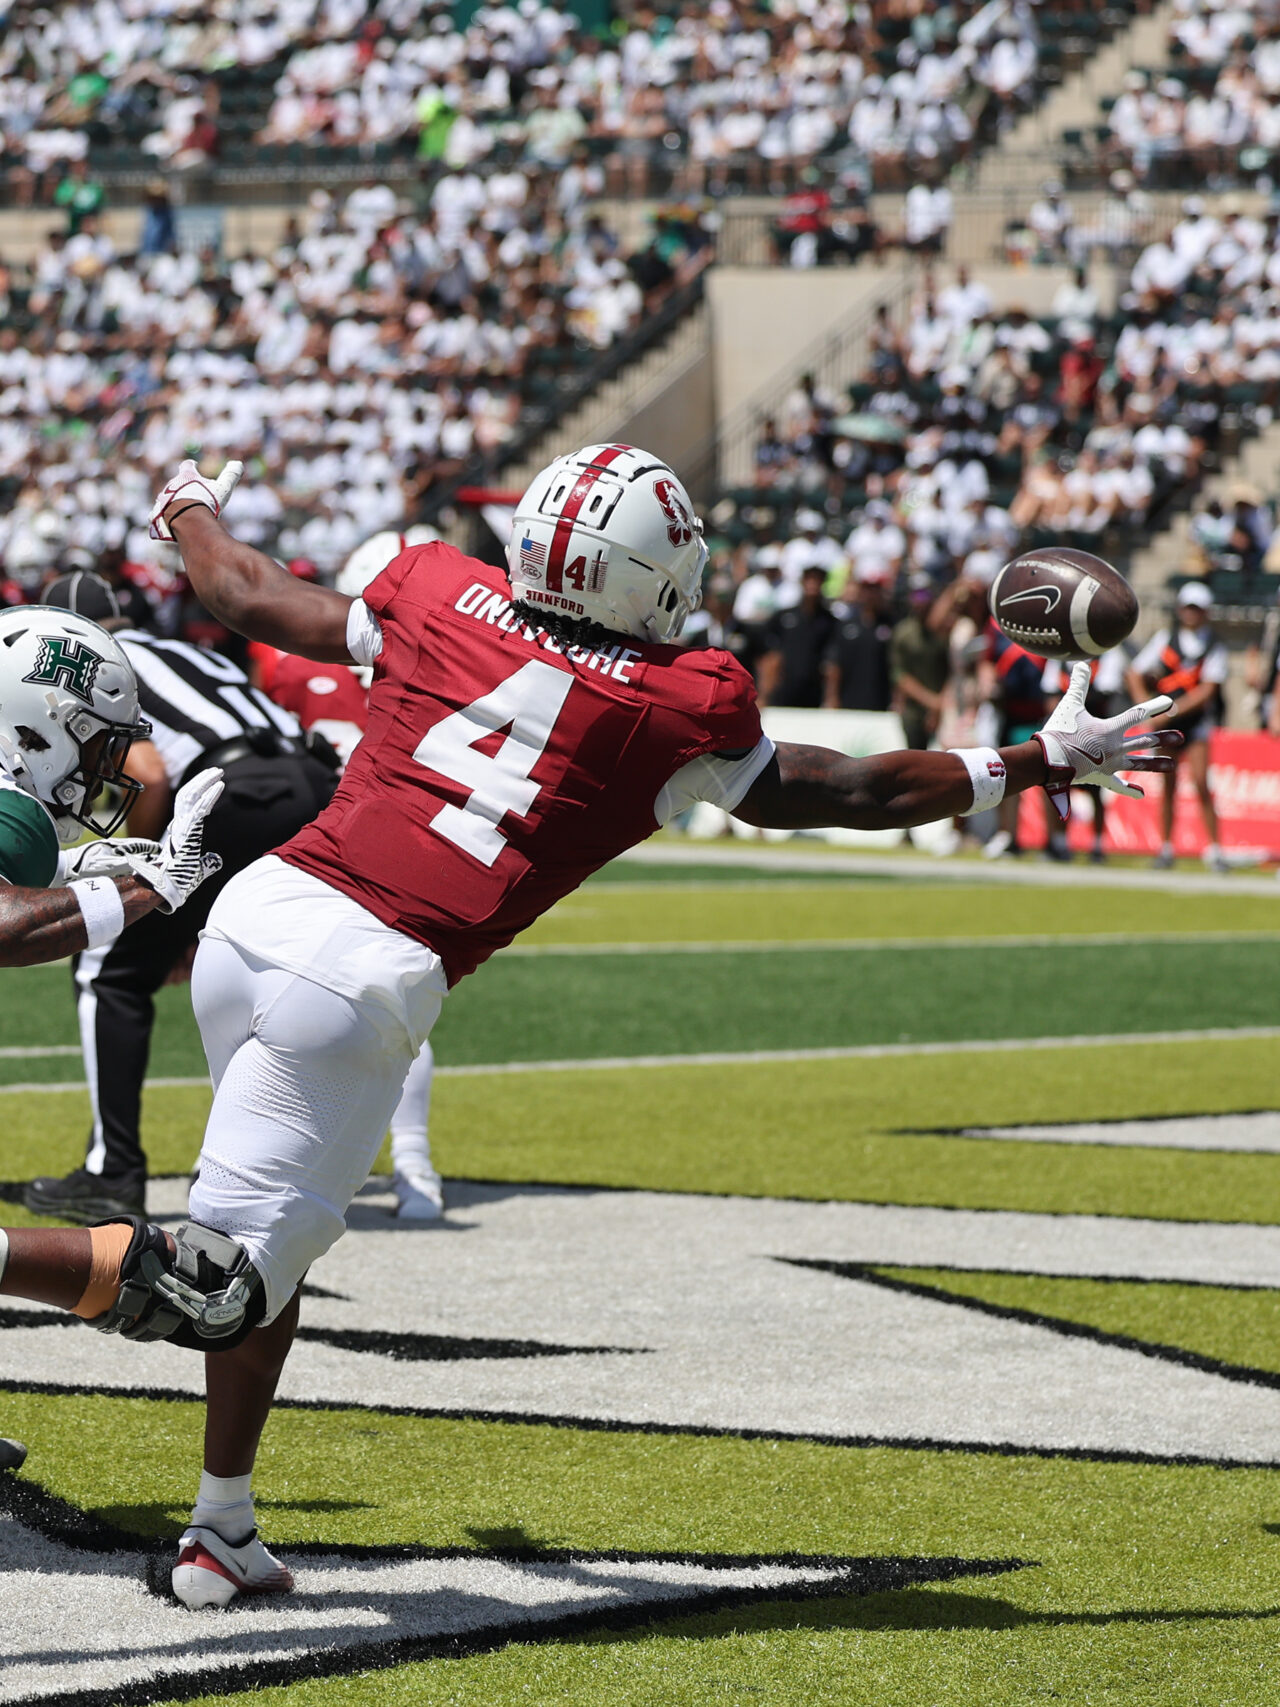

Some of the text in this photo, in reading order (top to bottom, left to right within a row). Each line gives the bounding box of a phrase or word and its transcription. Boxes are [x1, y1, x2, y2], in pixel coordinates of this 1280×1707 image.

[565, 556, 587, 591] 4
[526, 590, 584, 615] STANFORD
[22, 635, 105, 706] H
[412, 658, 576, 868] 4
